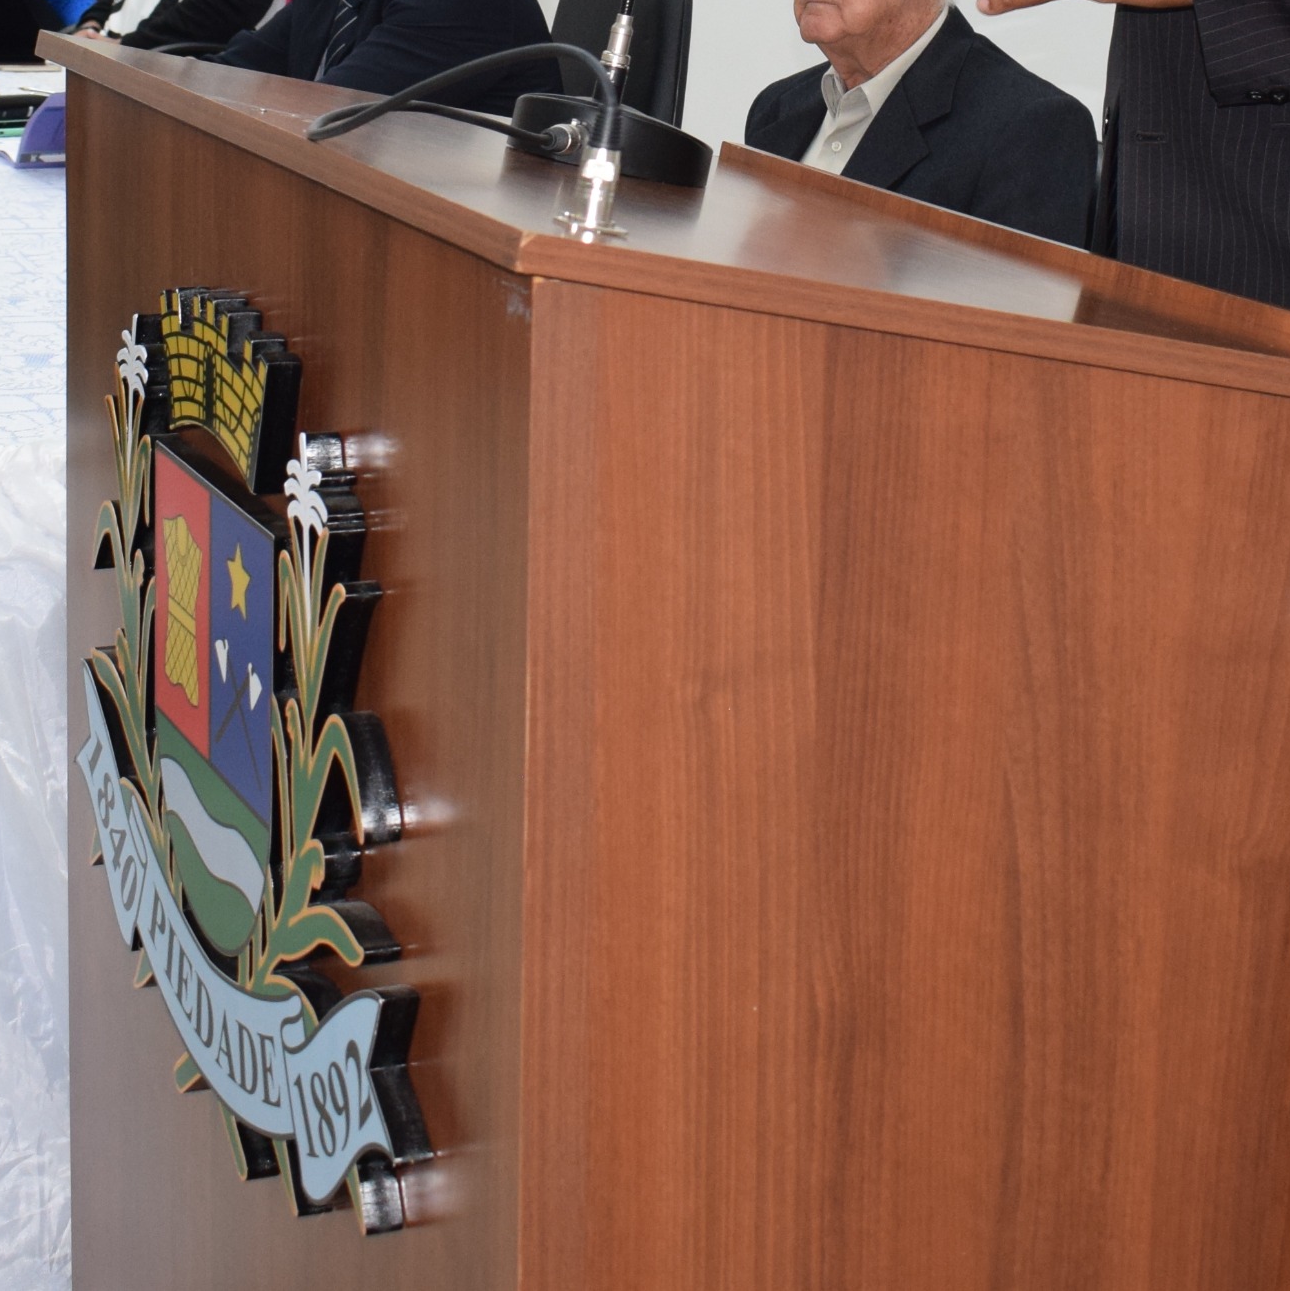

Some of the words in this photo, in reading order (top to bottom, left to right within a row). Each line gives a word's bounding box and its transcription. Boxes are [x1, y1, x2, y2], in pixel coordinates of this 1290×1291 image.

[87, 735, 138, 912] 1840
[147, 883, 282, 1109] PIEDADE
[293, 1039, 374, 1159] 1892
